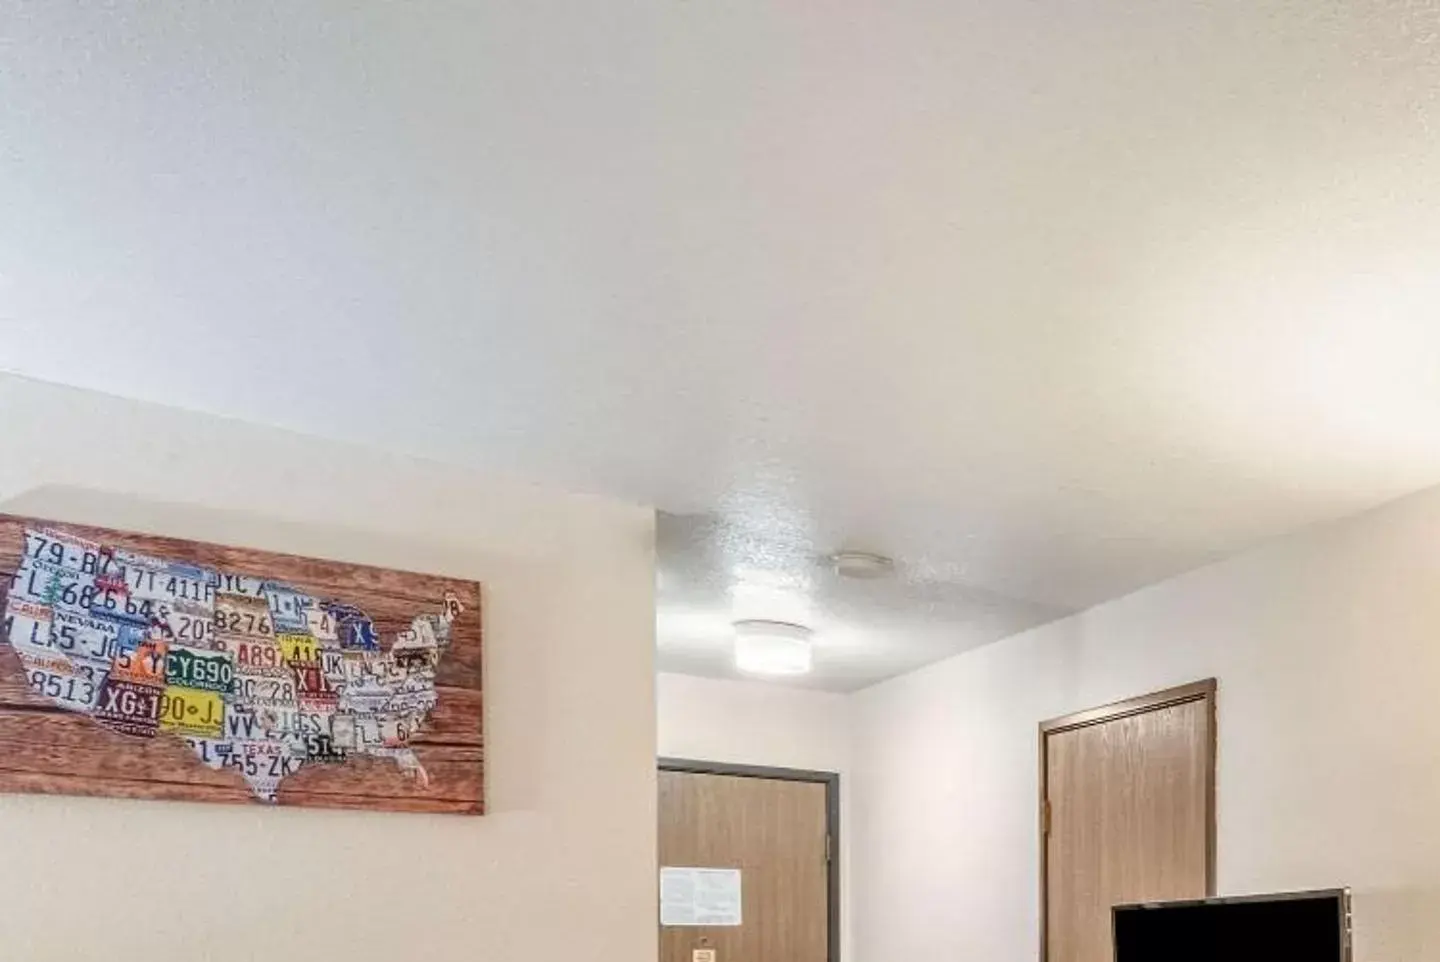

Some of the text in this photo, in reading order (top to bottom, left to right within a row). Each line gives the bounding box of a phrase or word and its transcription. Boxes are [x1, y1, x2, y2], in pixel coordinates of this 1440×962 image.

[56, 612, 115, 634] NEVADA
[214, 609, 271, 634] 8276
[166, 654, 233, 684] CY690
[242, 743, 282, 756] TEXAS
